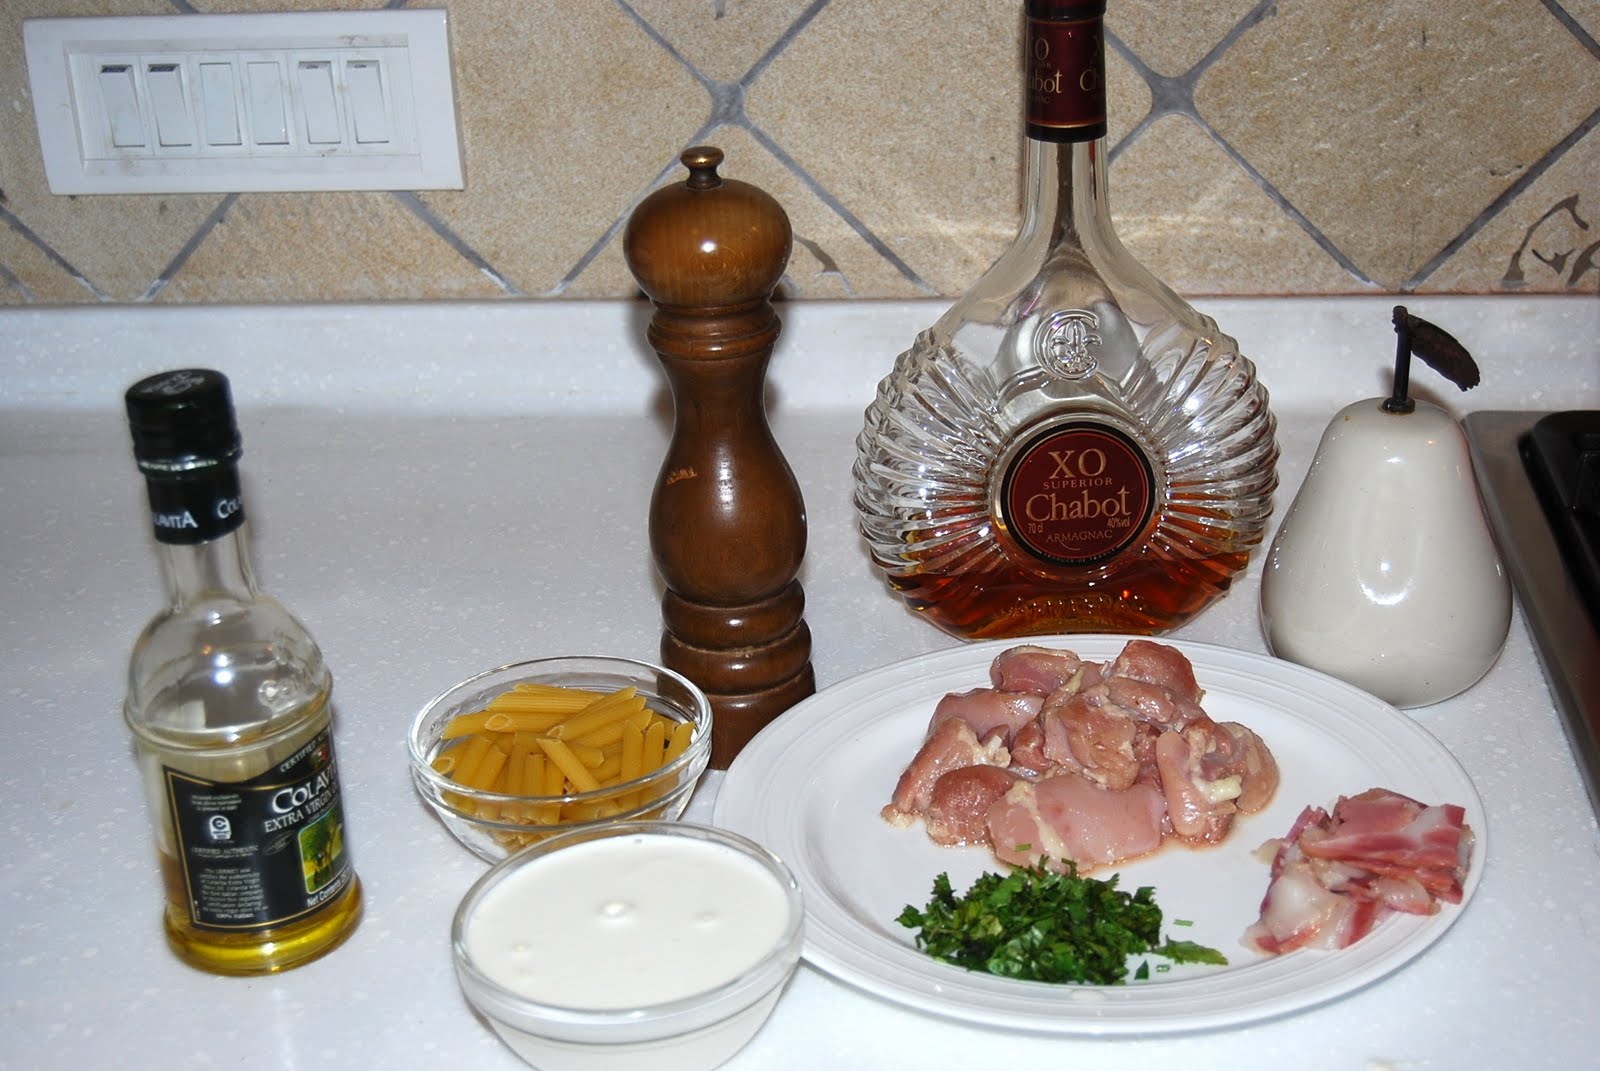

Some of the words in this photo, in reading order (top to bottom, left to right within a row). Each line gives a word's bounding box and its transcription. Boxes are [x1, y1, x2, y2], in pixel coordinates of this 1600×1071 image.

[1048, 448, 1107, 479] XO
[1043, 477, 1113, 490] SUPERIOR
[1025, 484, 1132, 522] Chabot
[1028, 522, 1037, 534] 70
[1046, 529, 1113, 544] ARMAGNAC
[264, 810, 305, 833] EXTRA
[305, 789, 333, 815] VIRGIN
[307, 894, 319, 908] Net
